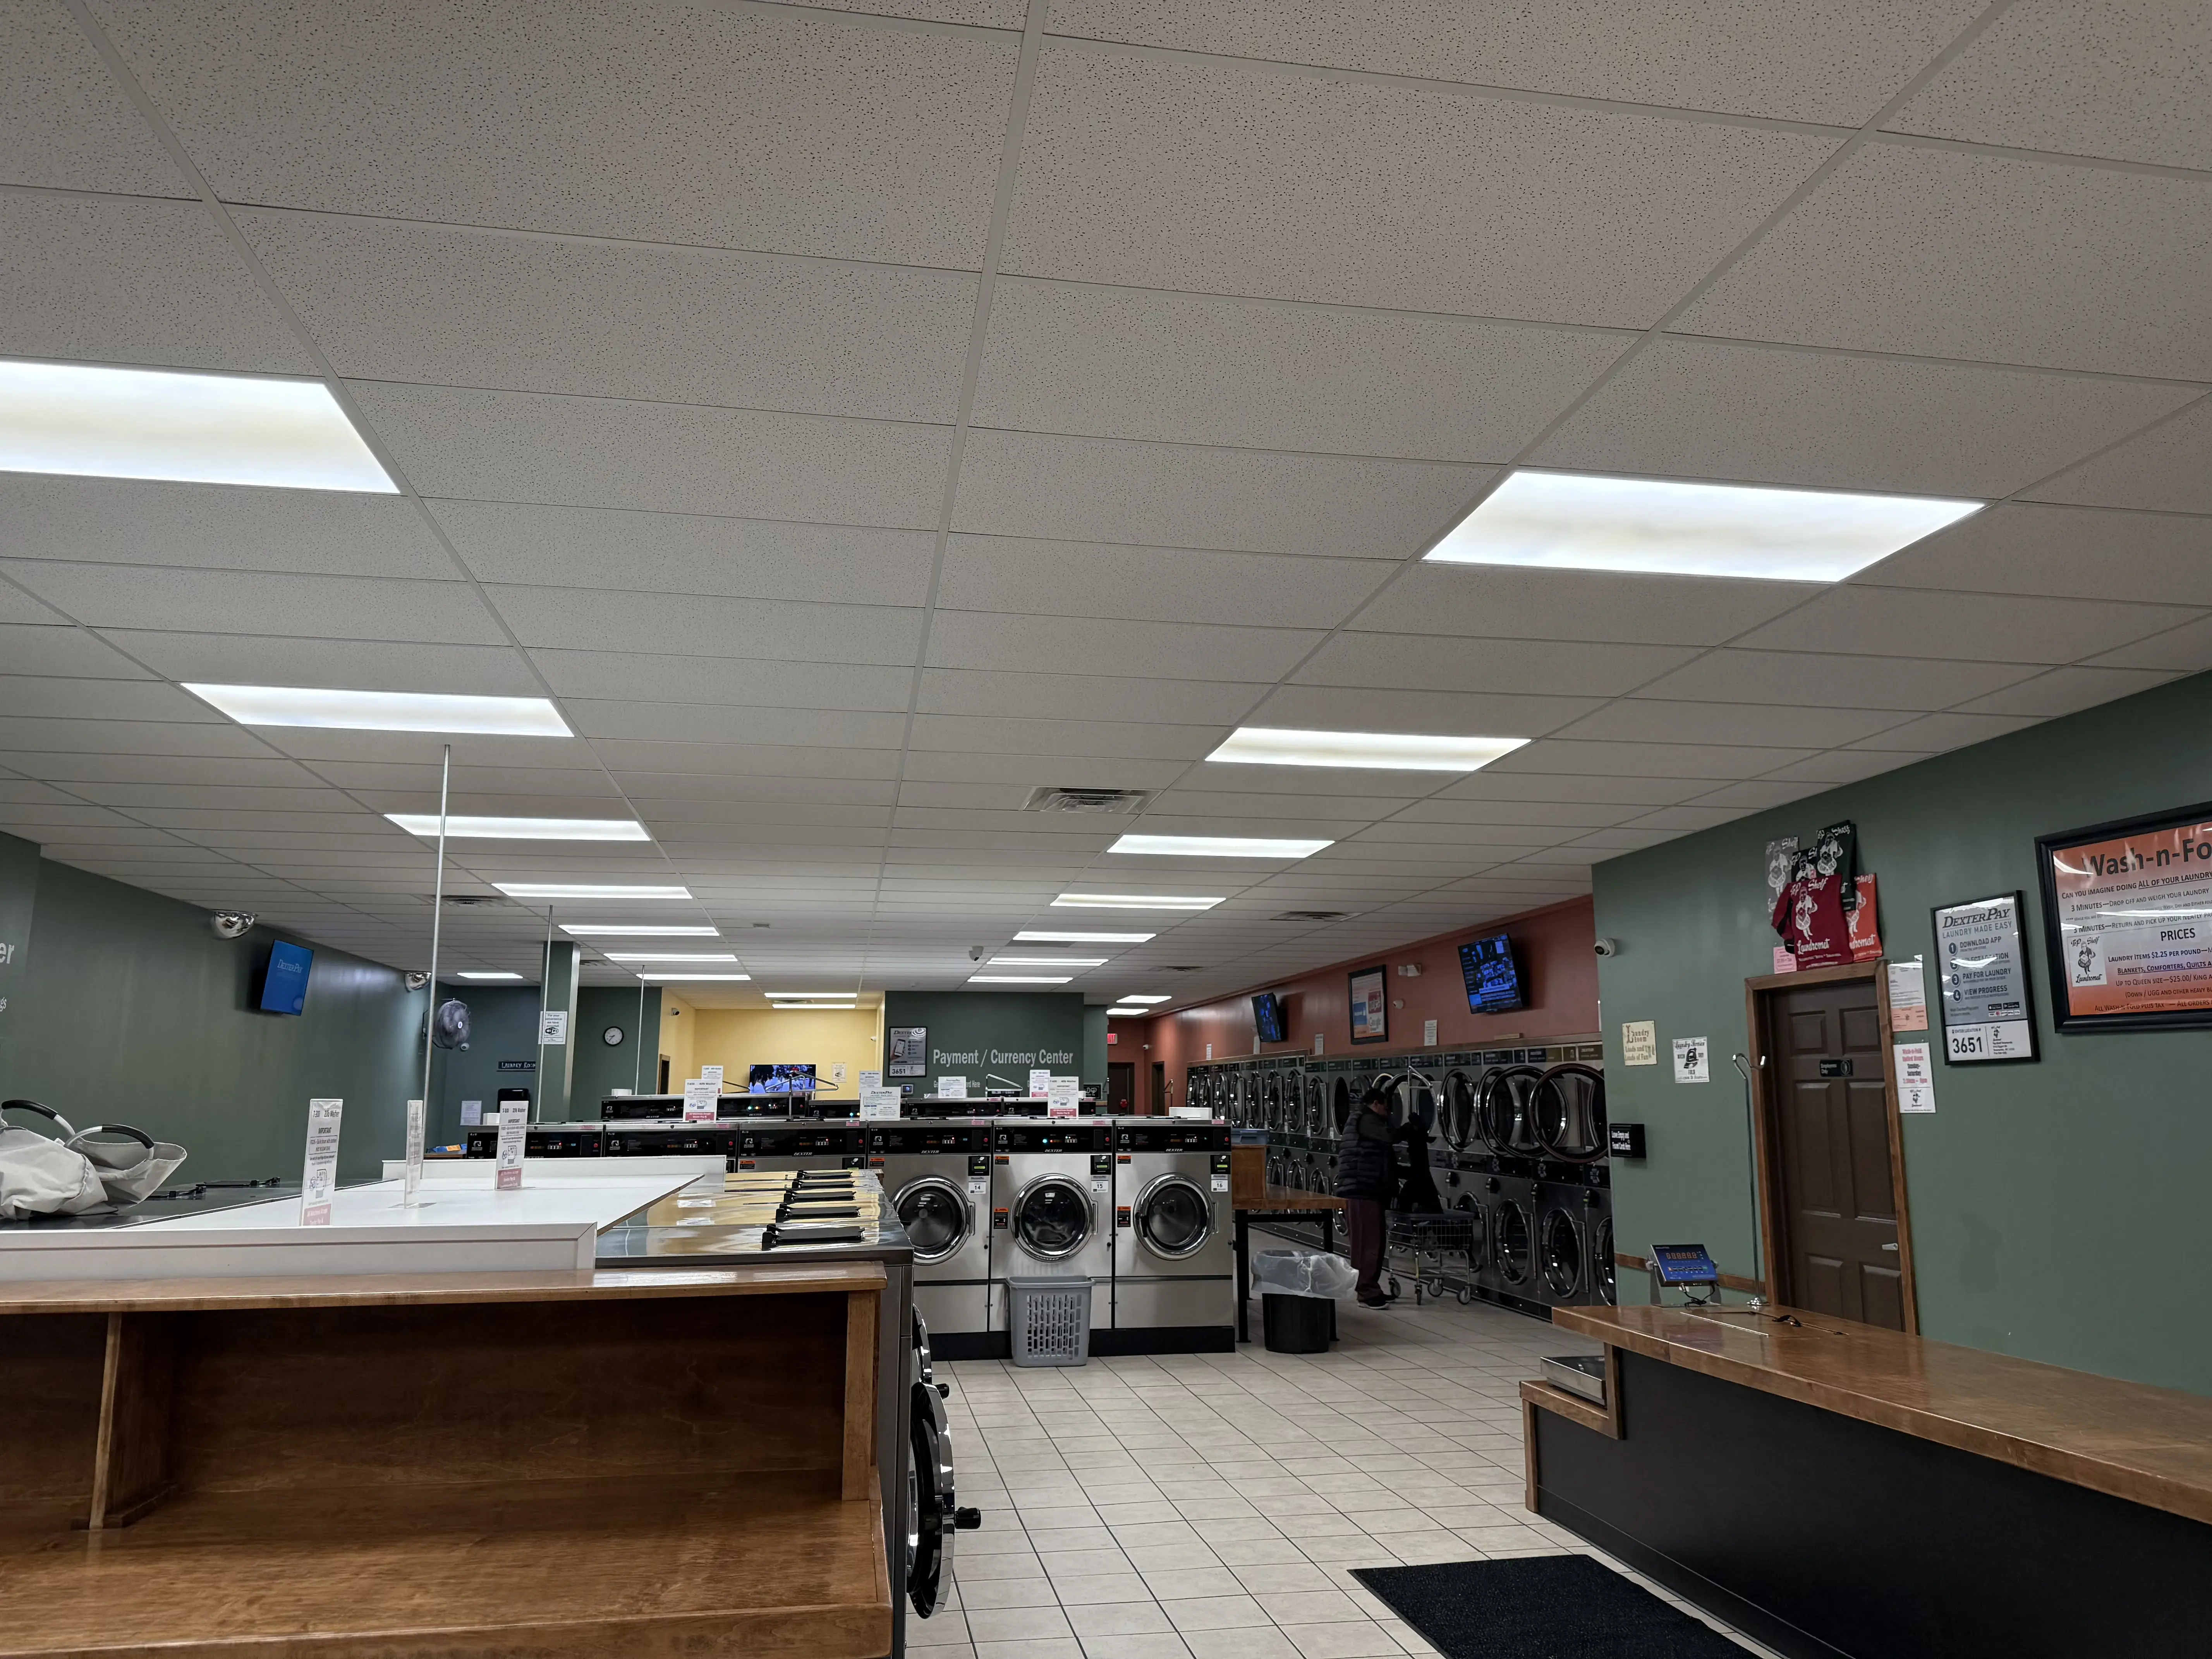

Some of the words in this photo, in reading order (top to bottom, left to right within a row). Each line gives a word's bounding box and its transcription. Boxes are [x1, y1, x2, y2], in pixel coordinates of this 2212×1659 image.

[1831, 825, 1850, 836] Shelf
[1808, 878, 1829, 891] Shelf
[2088, 886, 2114, 895] IMAGINE
[2183, 888, 2209, 896] LAUNDRY
[1942, 927, 1972, 939] LAUNDRY
[1974, 924, 1992, 933] MADE
[1995, 921, 2012, 930] EASY
[2160, 928, 2195, 941] PRICES
[1796, 938, 1830, 955] Laundromat
[1960, 938, 1989, 948] DOWNLOAD
[2152, 951, 2167, 959] $2.25
[1985, 968, 2011, 977] LAUNDRY
[2076, 974, 2102, 983] Laundromat
[1978, 985, 2008, 994] PROGRESS
[1952, 1036, 1982, 1053] 3651
[933, 1049, 979, 1067] Payment
[980, 1049, 988, 1067] /
[991, 1049, 1036, 1067] Currency
[1039, 1049, 1073, 1064] Center
